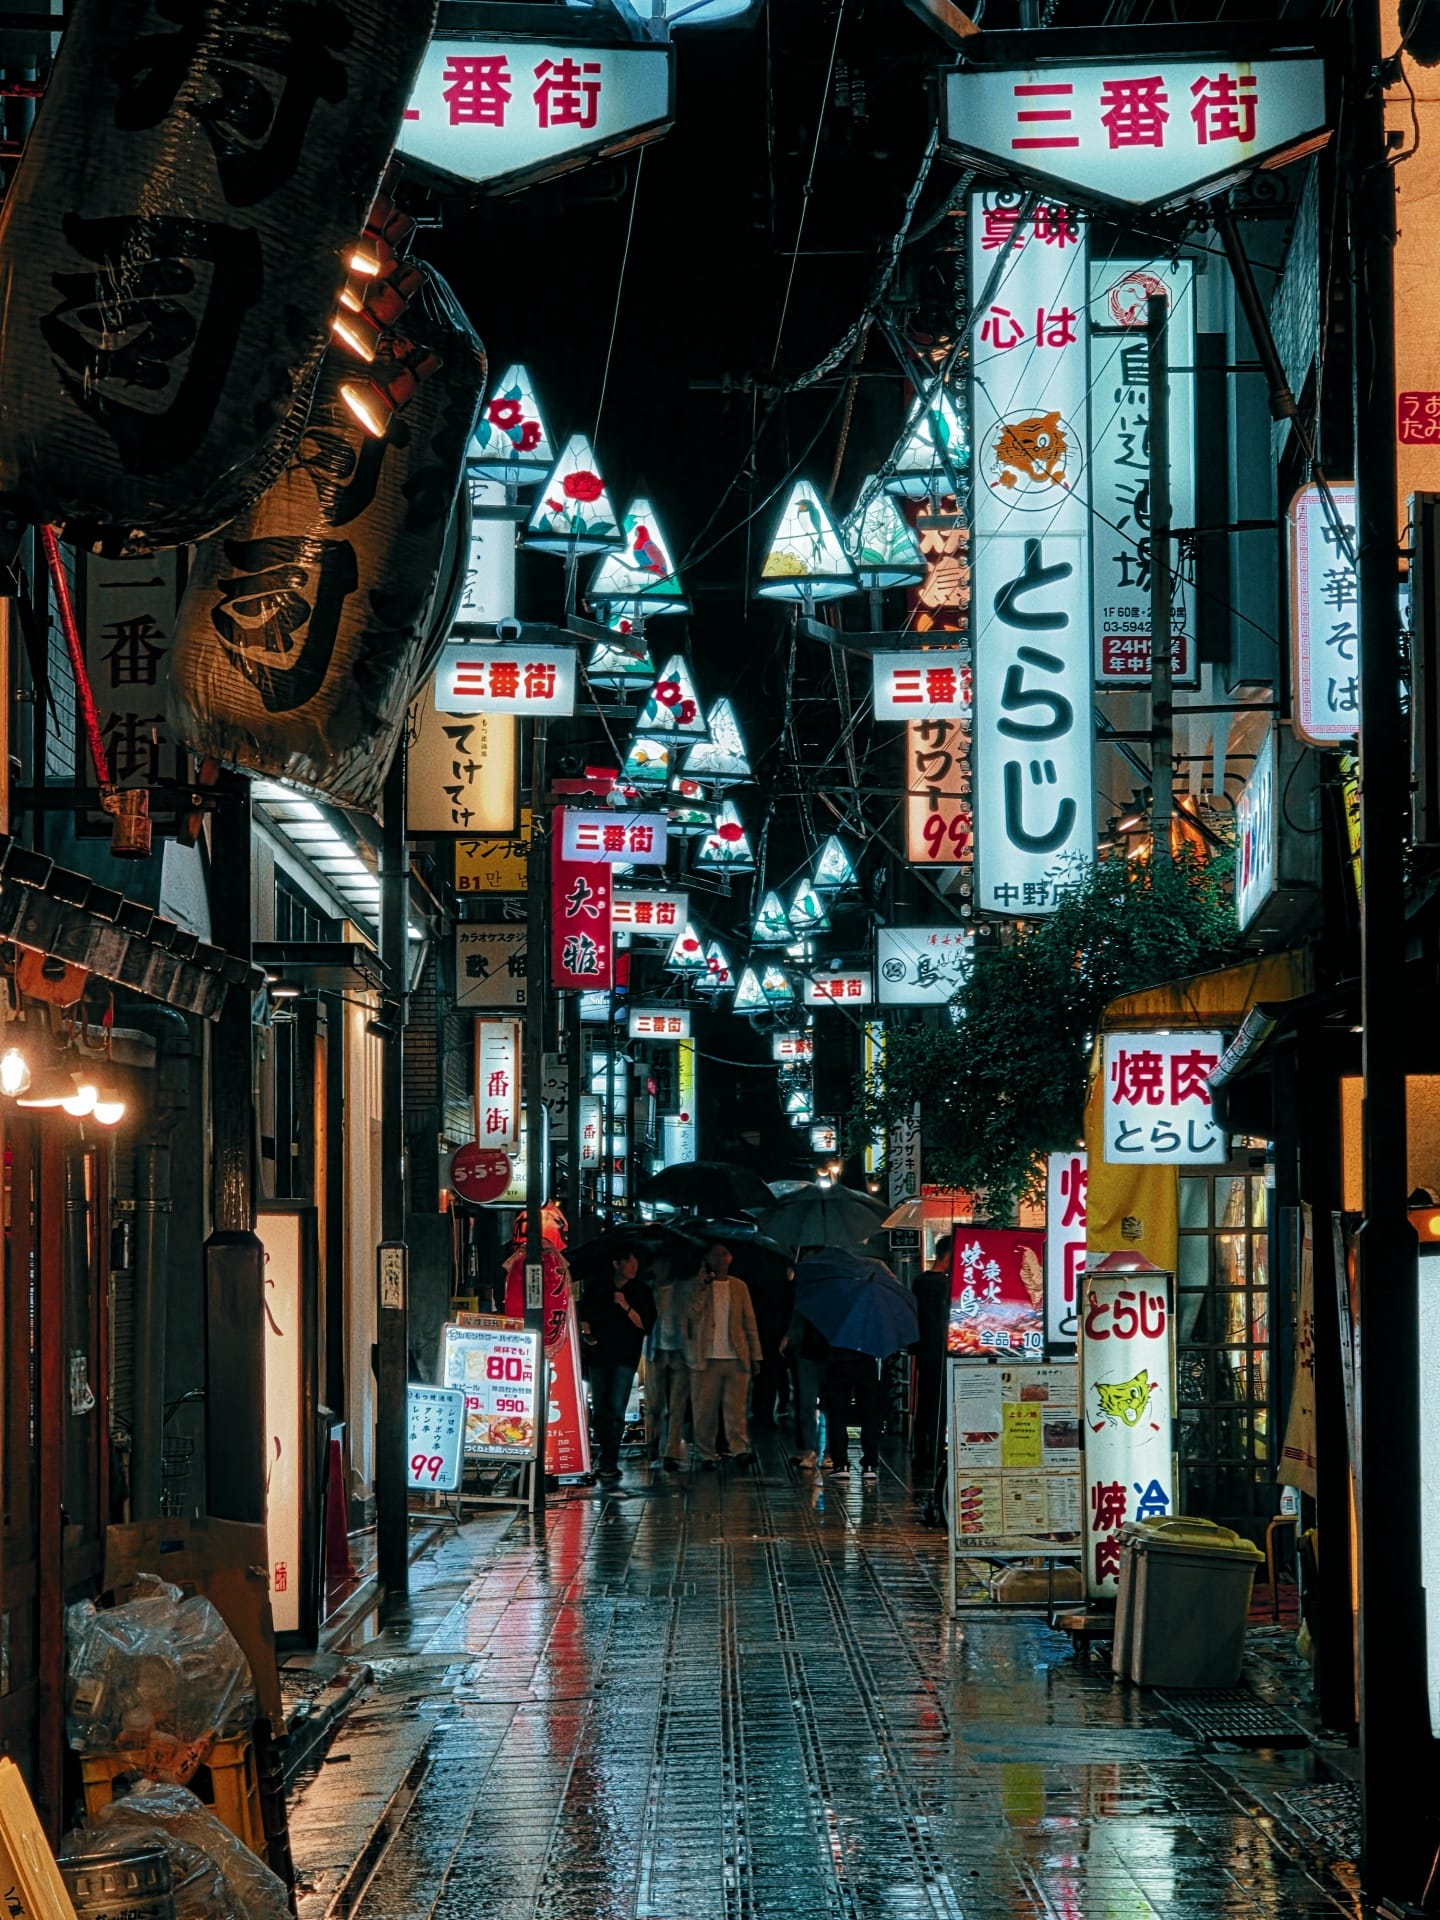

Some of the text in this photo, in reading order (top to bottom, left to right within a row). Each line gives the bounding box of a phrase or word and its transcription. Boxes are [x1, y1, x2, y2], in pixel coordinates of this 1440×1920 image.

[403, 54, 602, 129] 番街
[1011, 73, 1259, 150] 三番街
[453, 661, 556, 699] 三番街
[892, 667, 972, 704] 三番
[993, 536, 1078, 855] とらじ
[442, 724, 482, 828] てけてけ
[459, 839, 530, 859] マンナ
[575, 825, 654, 853] 三番街
[459, 876, 480, 890] B1
[563, 877, 602, 975] 大雅
[613, 901, 676, 925] 三番街
[460, 932, 528, 943] カラオケスタジ
[516, 989, 526, 1003] B
[813, 979, 862, 998] 三番街
[637, 1016, 682, 1033] 三番街
[485, 1036, 510, 1135] 三番街
[1111, 1049, 1219, 1106] 焼肉
[1114, 1118, 1217, 1154] とらじ
[960, 1240, 986, 1318] 焼き鳥
[1085, 1290, 1165, 1340] とらじ
[980, 1330, 1010, 1346] 全品
[486, 1356, 522, 1382] 80
[496, 1398, 525, 1413] 990
[411, 1454, 444, 1482] 99
